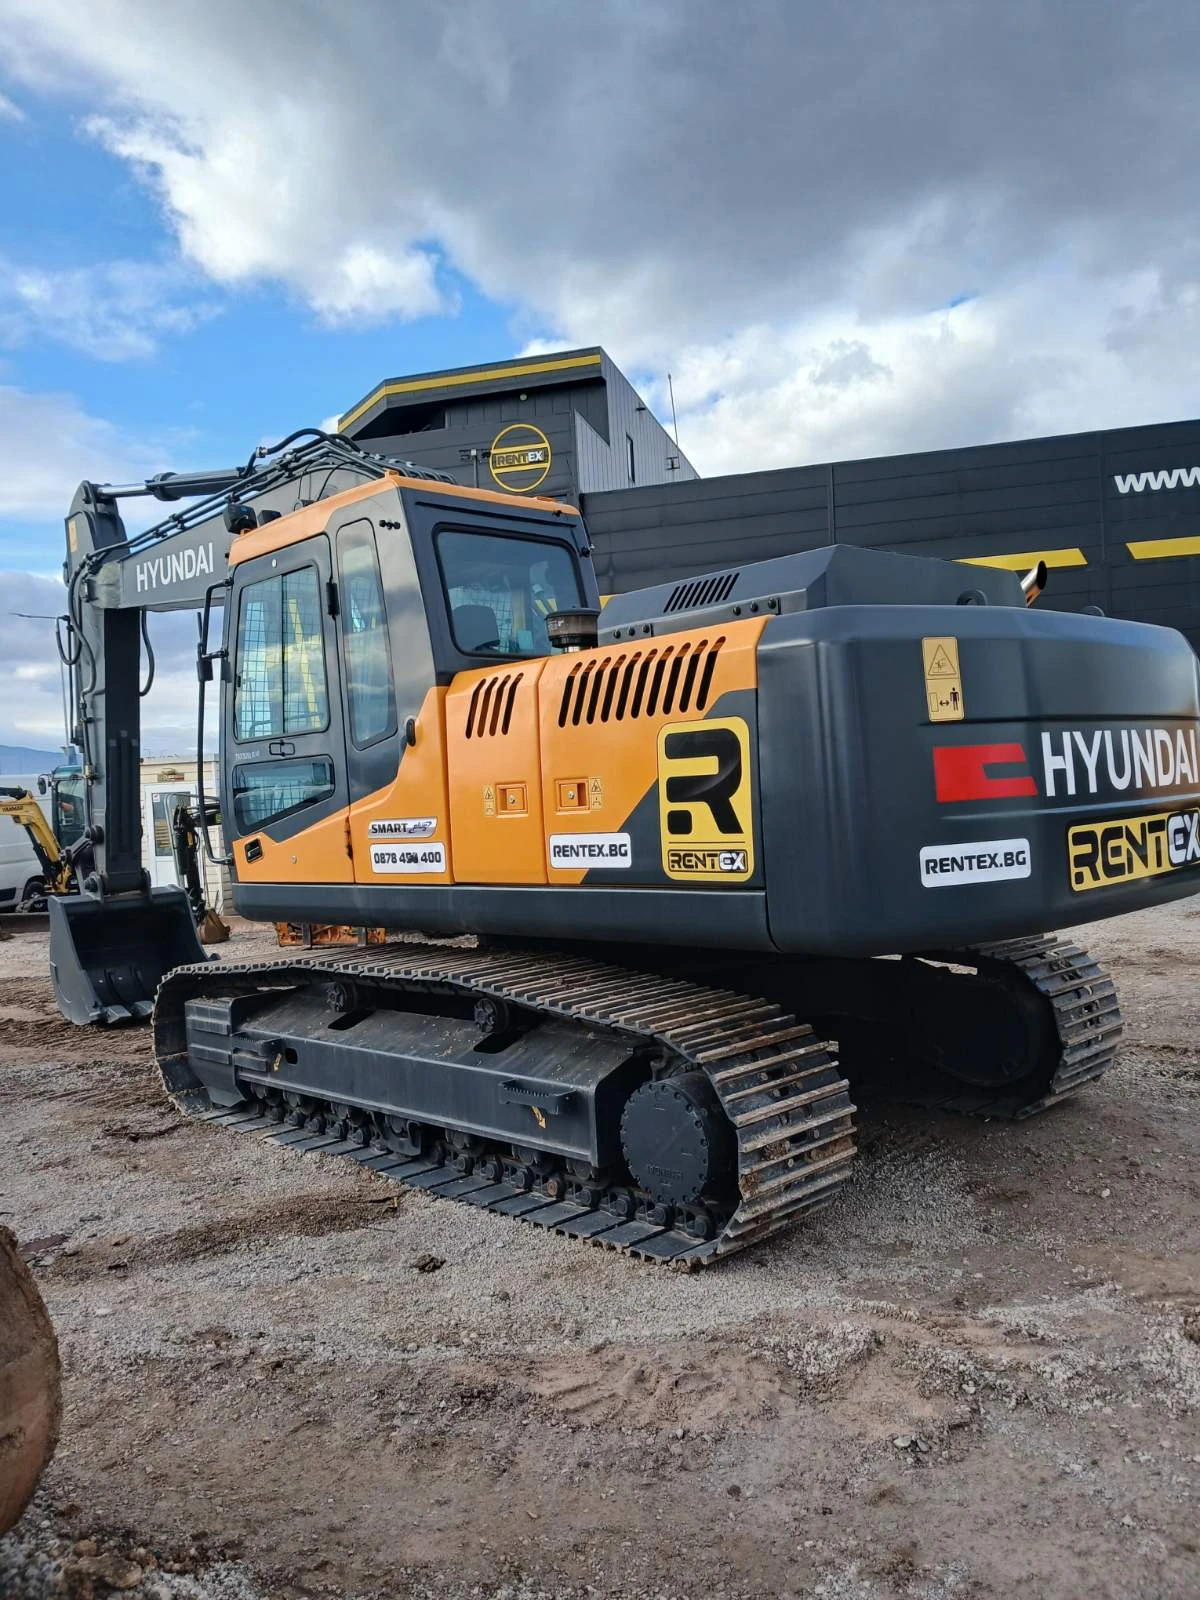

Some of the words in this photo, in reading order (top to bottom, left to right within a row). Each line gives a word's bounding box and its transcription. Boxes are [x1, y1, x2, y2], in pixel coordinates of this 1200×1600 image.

[496, 451, 543, 467] RENTEX
[136, 542, 214, 592] HYUNDAI
[1041, 729, 1199, 796] HYUNDAI
[371, 823, 408, 834] SMART
[374, 853, 398, 864] 0878
[421, 851, 442, 863] 400
[553, 843, 628, 858] RENTEX.BG
[1071, 812, 1200, 885] RENTEX
[670, 851, 745, 870] RENTEX
[925, 850, 1026, 875] RENTEX.BG
